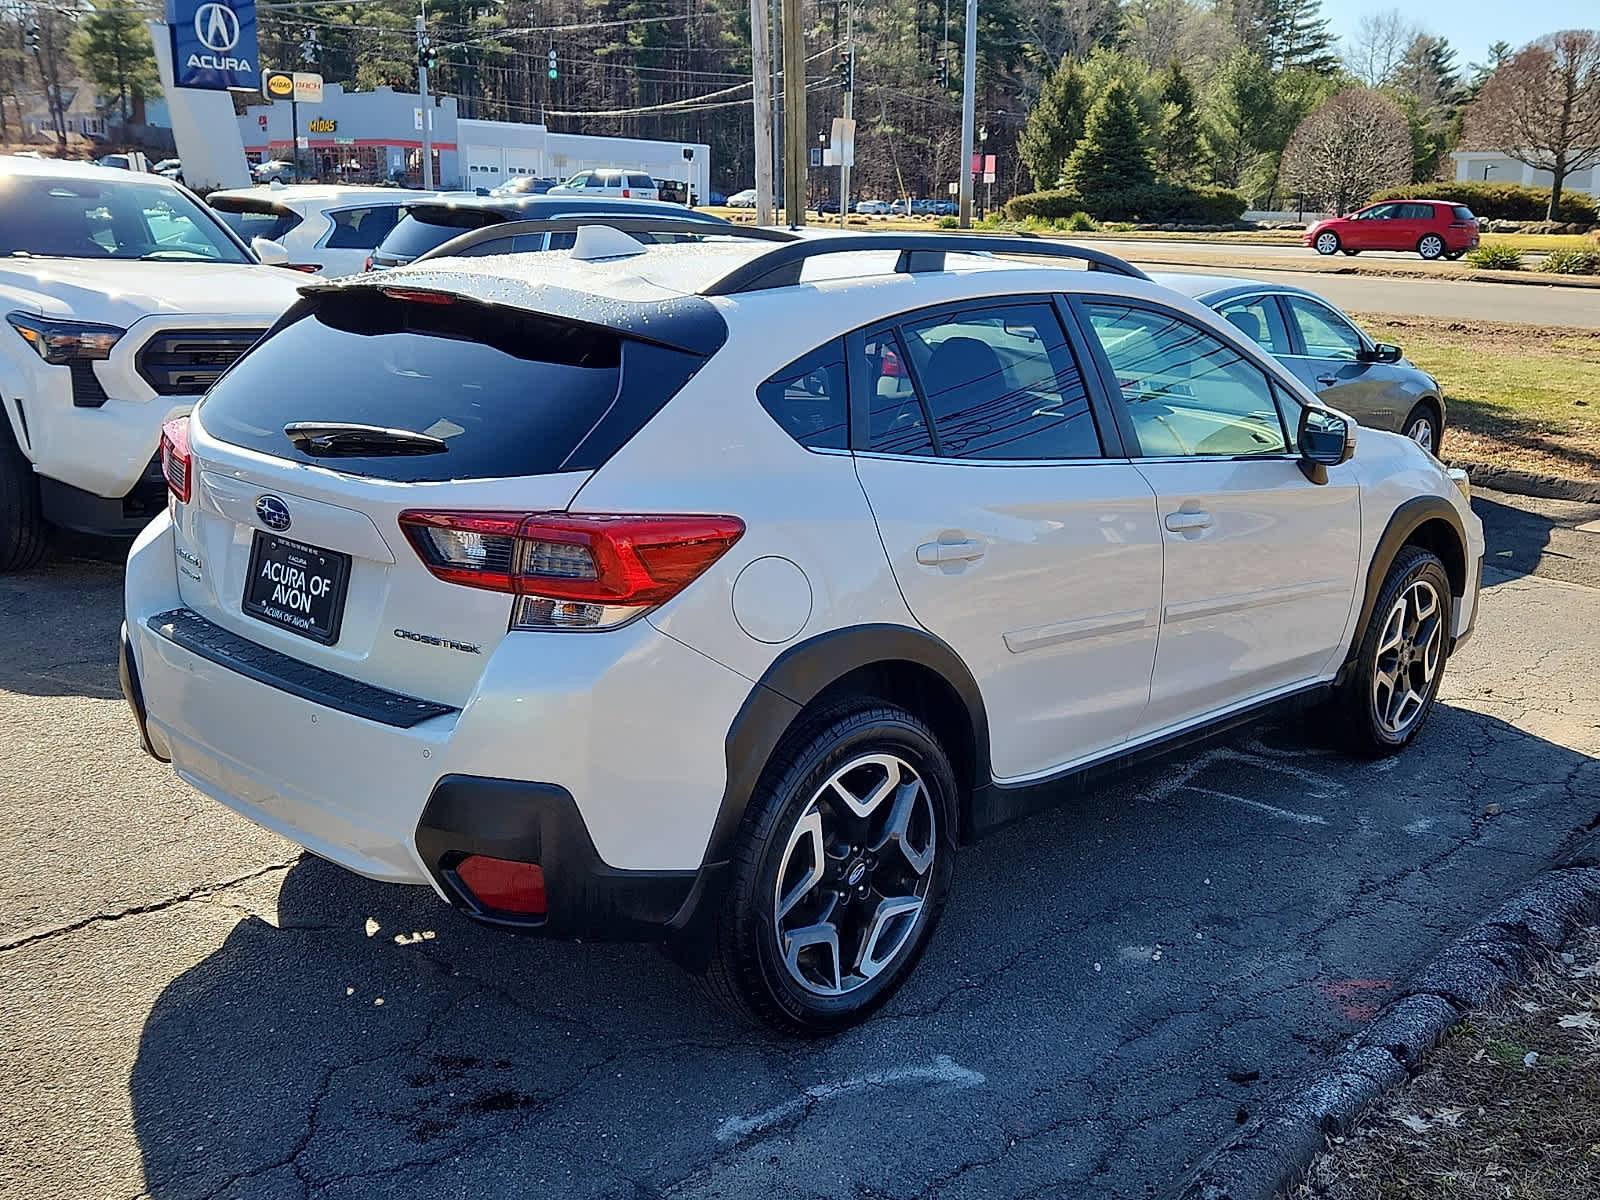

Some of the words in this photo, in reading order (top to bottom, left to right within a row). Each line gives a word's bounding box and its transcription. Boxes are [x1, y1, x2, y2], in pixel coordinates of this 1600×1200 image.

[187, 54, 252, 72] ACURA
[271, 78, 291, 89] MIDAS
[309, 119, 335, 132] MIDAS
[261, 559, 306, 592] ACURA
[309, 575, 331, 598] OF
[271, 583, 312, 613] AVON
[263, 606, 283, 620] ACURA
[283, 612, 292, 623] OF
[291, 615, 309, 630] AVON
[393, 628, 481, 654] CROSSTREK
